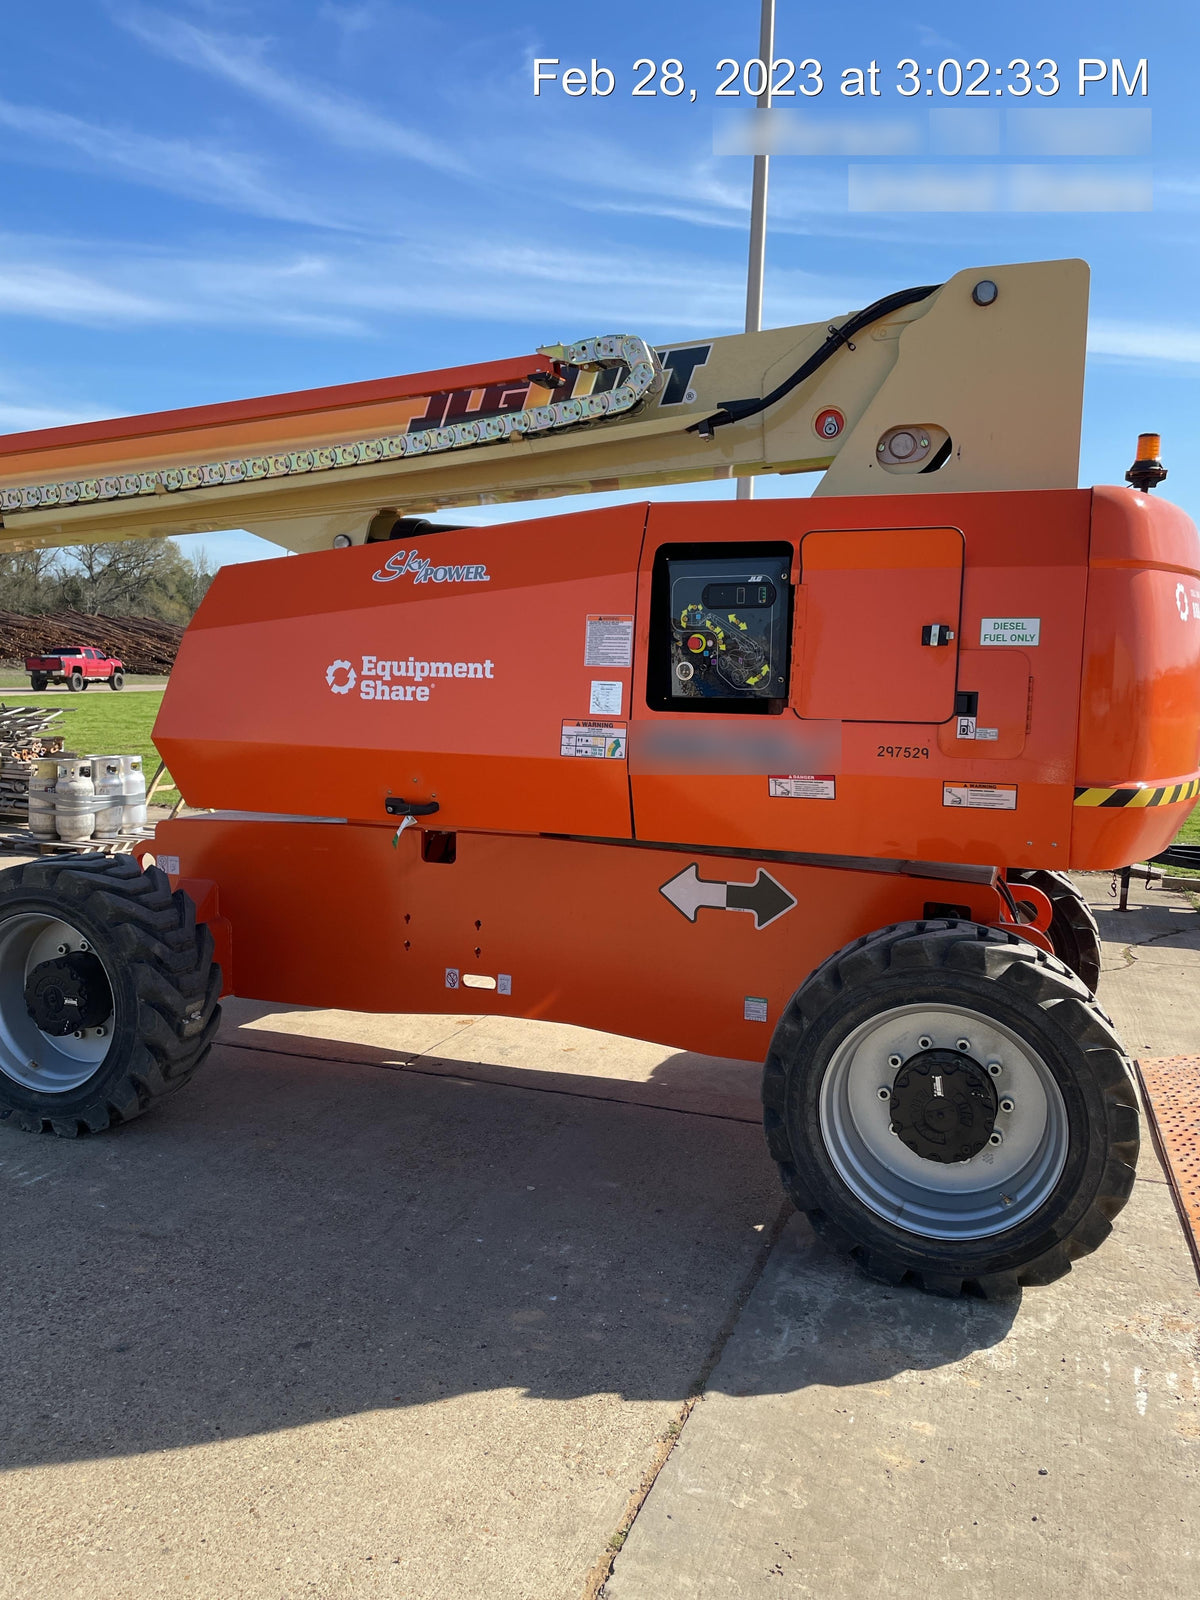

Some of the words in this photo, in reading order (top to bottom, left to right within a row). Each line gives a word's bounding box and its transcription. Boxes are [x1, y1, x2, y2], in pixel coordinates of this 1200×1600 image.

[993, 622, 1027, 631] DIESEL
[983, 633, 1008, 642] FUEL
[1010, 633, 1036, 642] ONLY
[361, 655, 495, 681] Equipment
[360, 680, 430, 701] Share
[582, 721, 614, 729] WARNING
[877, 745, 929, 759] 297529
